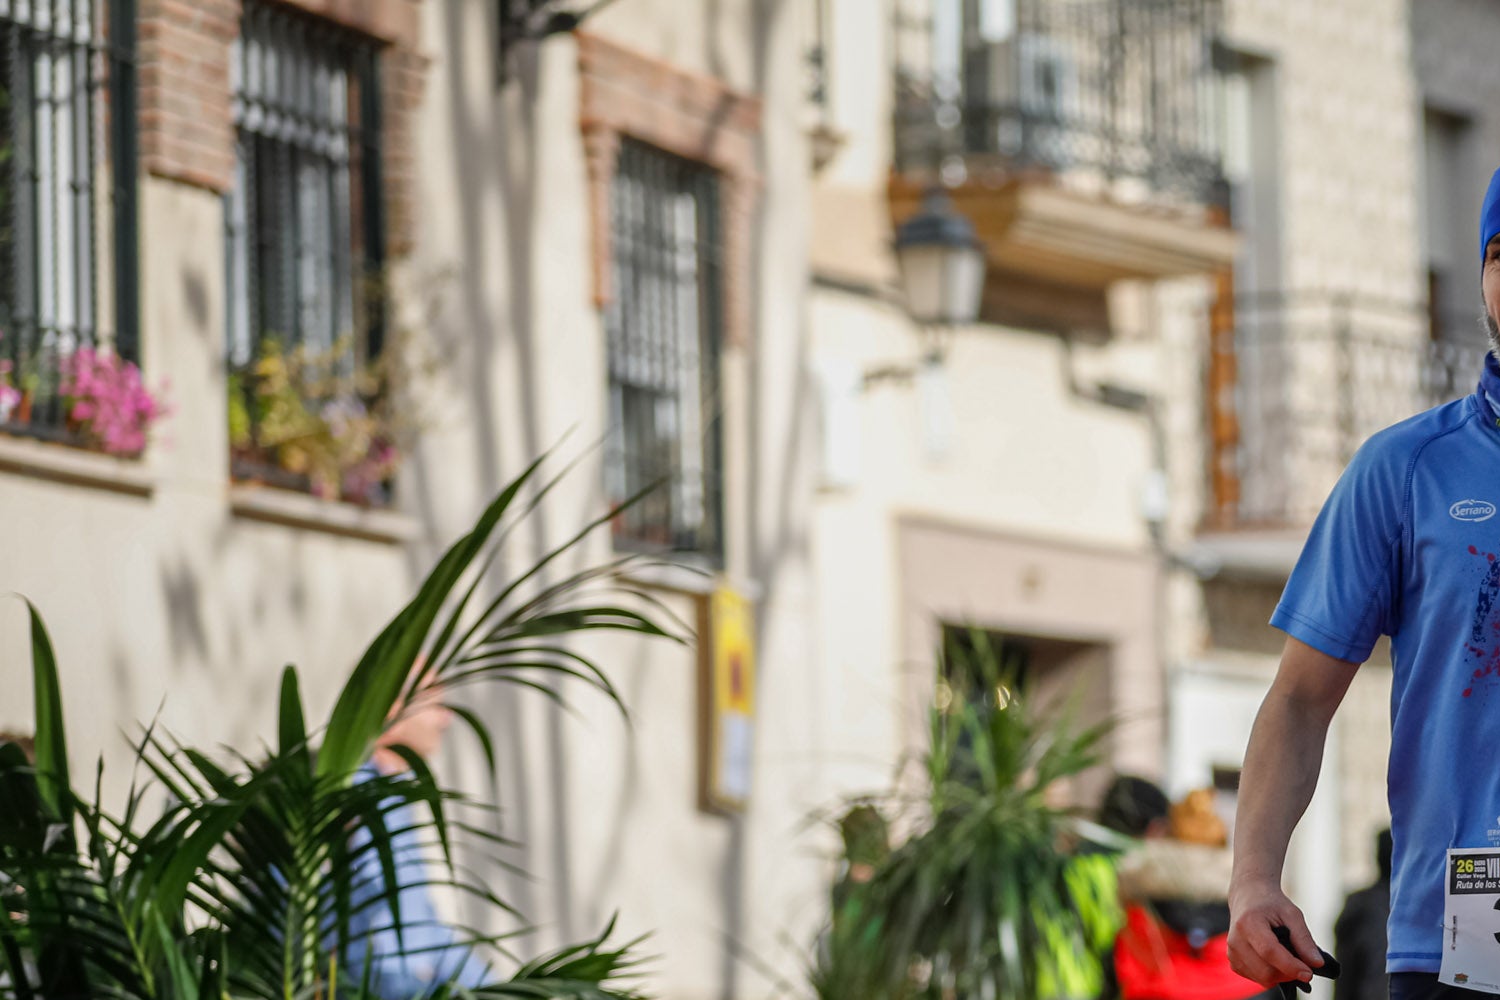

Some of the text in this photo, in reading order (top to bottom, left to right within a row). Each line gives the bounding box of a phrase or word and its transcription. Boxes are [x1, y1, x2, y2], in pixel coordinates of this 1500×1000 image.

[1454, 505, 1492, 516] Serrano
[1456, 859, 1474, 873] 26
[1487, 858, 1500, 878] VII
[1456, 880, 1473, 889] Ruta
[1475, 880, 1484, 888] de
[1485, 880, 1496, 888] los
